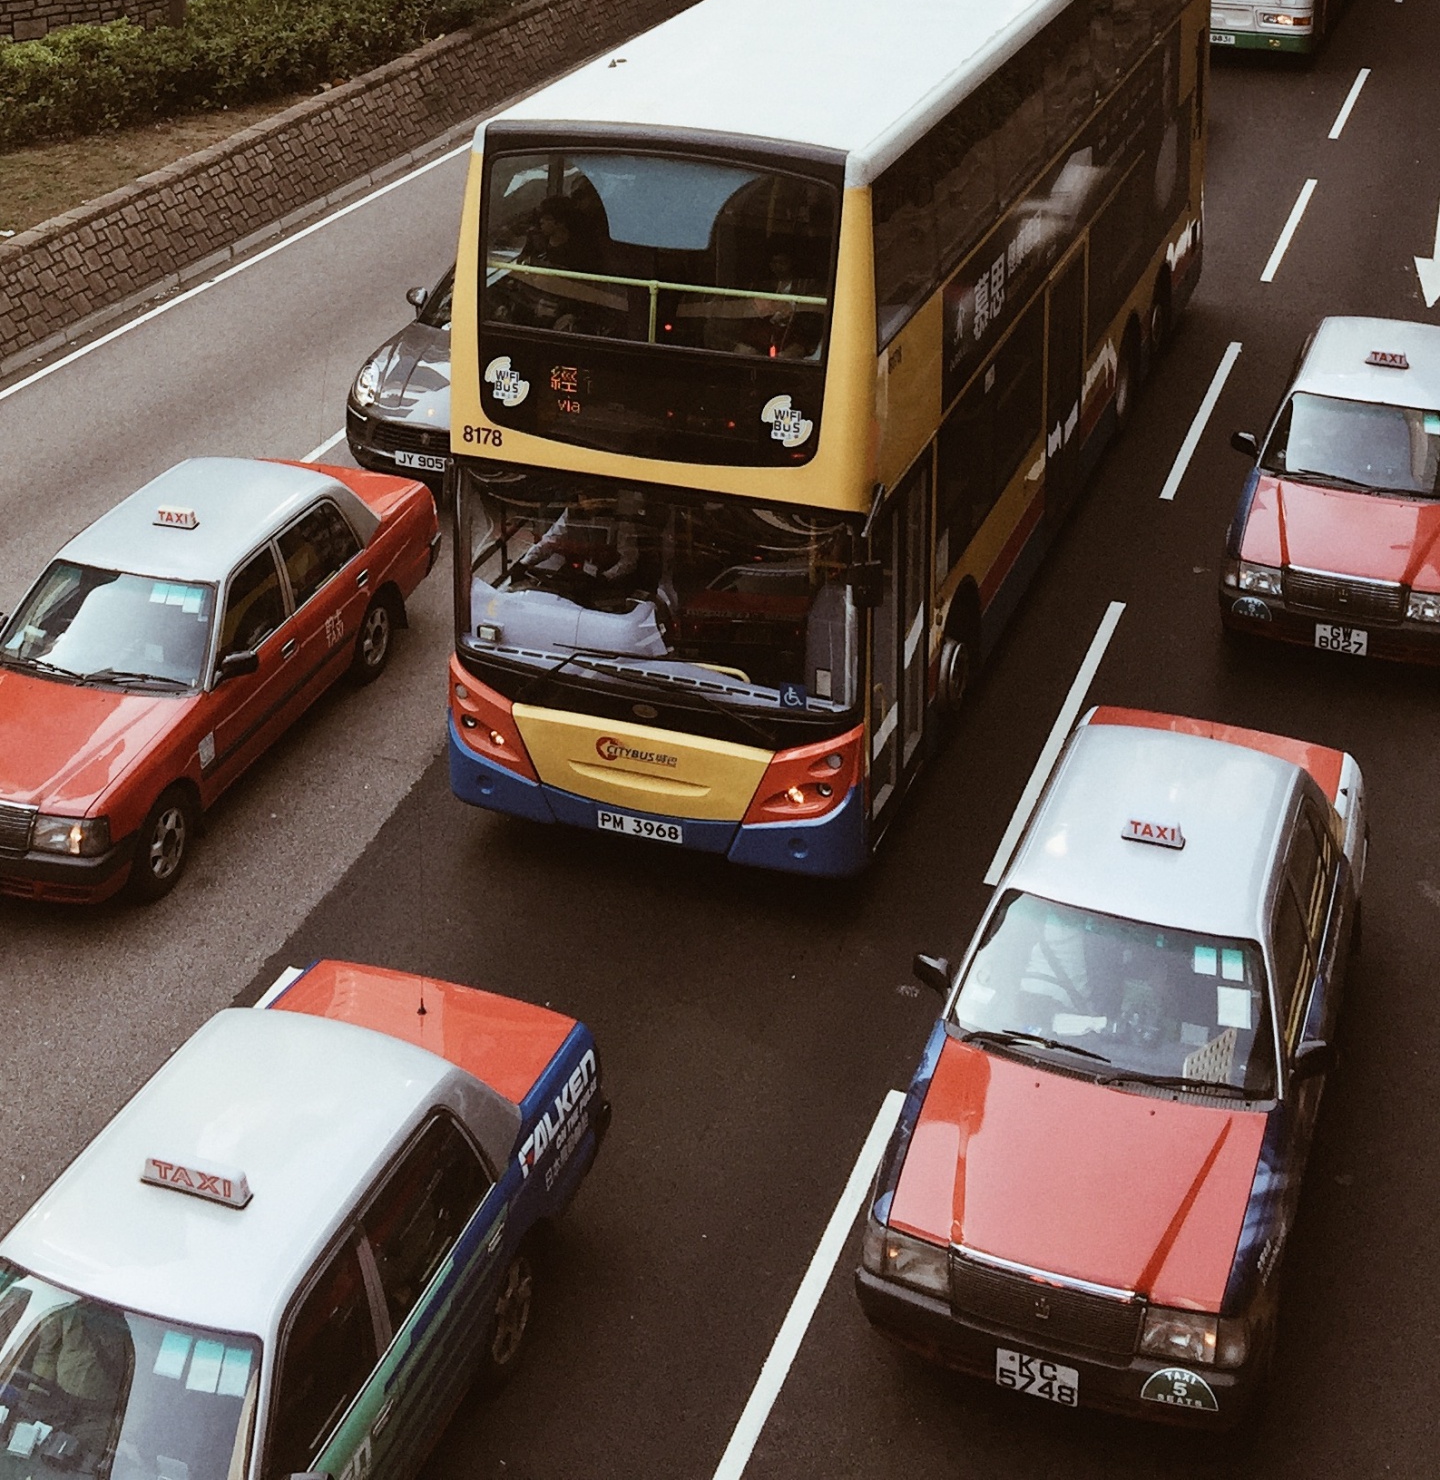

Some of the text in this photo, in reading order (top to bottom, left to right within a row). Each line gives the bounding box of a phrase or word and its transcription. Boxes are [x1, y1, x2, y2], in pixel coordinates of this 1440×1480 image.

[1371, 351, 1405, 365] TAXI
[496, 369, 519, 383] WIFI
[550, 365, 578, 393] 經
[495, 380, 519, 394] BUS
[557, 395, 580, 413] via
[773, 408, 801, 422] WIFI
[773, 420, 801, 434] BUS
[463, 424, 503, 448] 8178
[398, 452, 415, 466] JY
[158, 510, 188, 525] TAXI
[1330, 626, 1353, 641] GW
[1318, 635, 1364, 654] 8027
[606, 744, 655, 763] CITYBUS
[600, 812, 680, 841] PM 3968
[1130, 819, 1176, 842] TAXI
[518, 1048, 597, 1179] FALKEN
[151, 1159, 232, 1198] TAXI
[1018, 1354, 1058, 1382] KC
[998, 1366, 1075, 1405] 5748
[1164, 1371, 1197, 1385] TAXI
[1172, 1381, 1188, 1397] 5
[1157, 1393, 1203, 1408] SEATS
